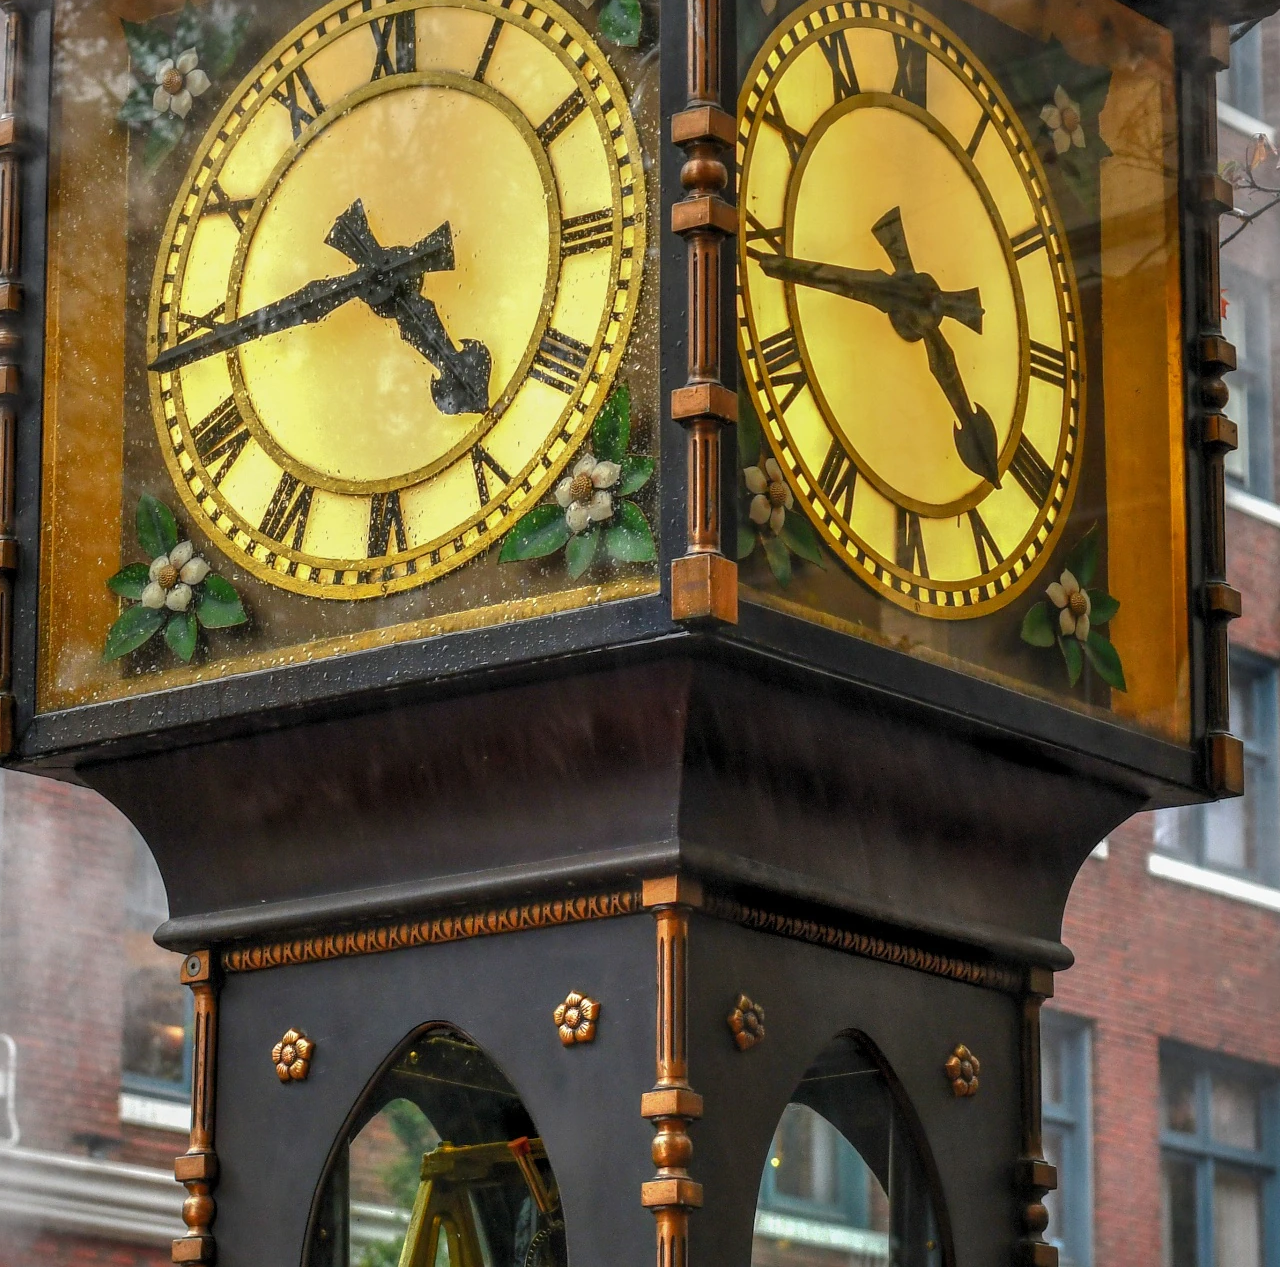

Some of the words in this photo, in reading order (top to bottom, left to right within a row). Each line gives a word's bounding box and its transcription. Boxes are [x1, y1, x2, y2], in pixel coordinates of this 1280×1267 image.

[370, 10, 417, 82] XII
[474, 18, 504, 81] I
[818, 31, 860, 104] XI
[271, 66, 326, 140] XI
[536, 87, 588, 146] II
[760, 89, 807, 166] X
[966, 111, 992, 162] I
[201, 180, 255, 234] X
[561, 209, 613, 256] III
[1011, 223, 1047, 261] II
[1029, 339, 1065, 388] III
[471, 443, 513, 508] V
[259, 471, 314, 551] VII
[368, 491, 408, 558] VI
[896, 508, 930, 579] VI
[967, 509, 1005, 574] V
